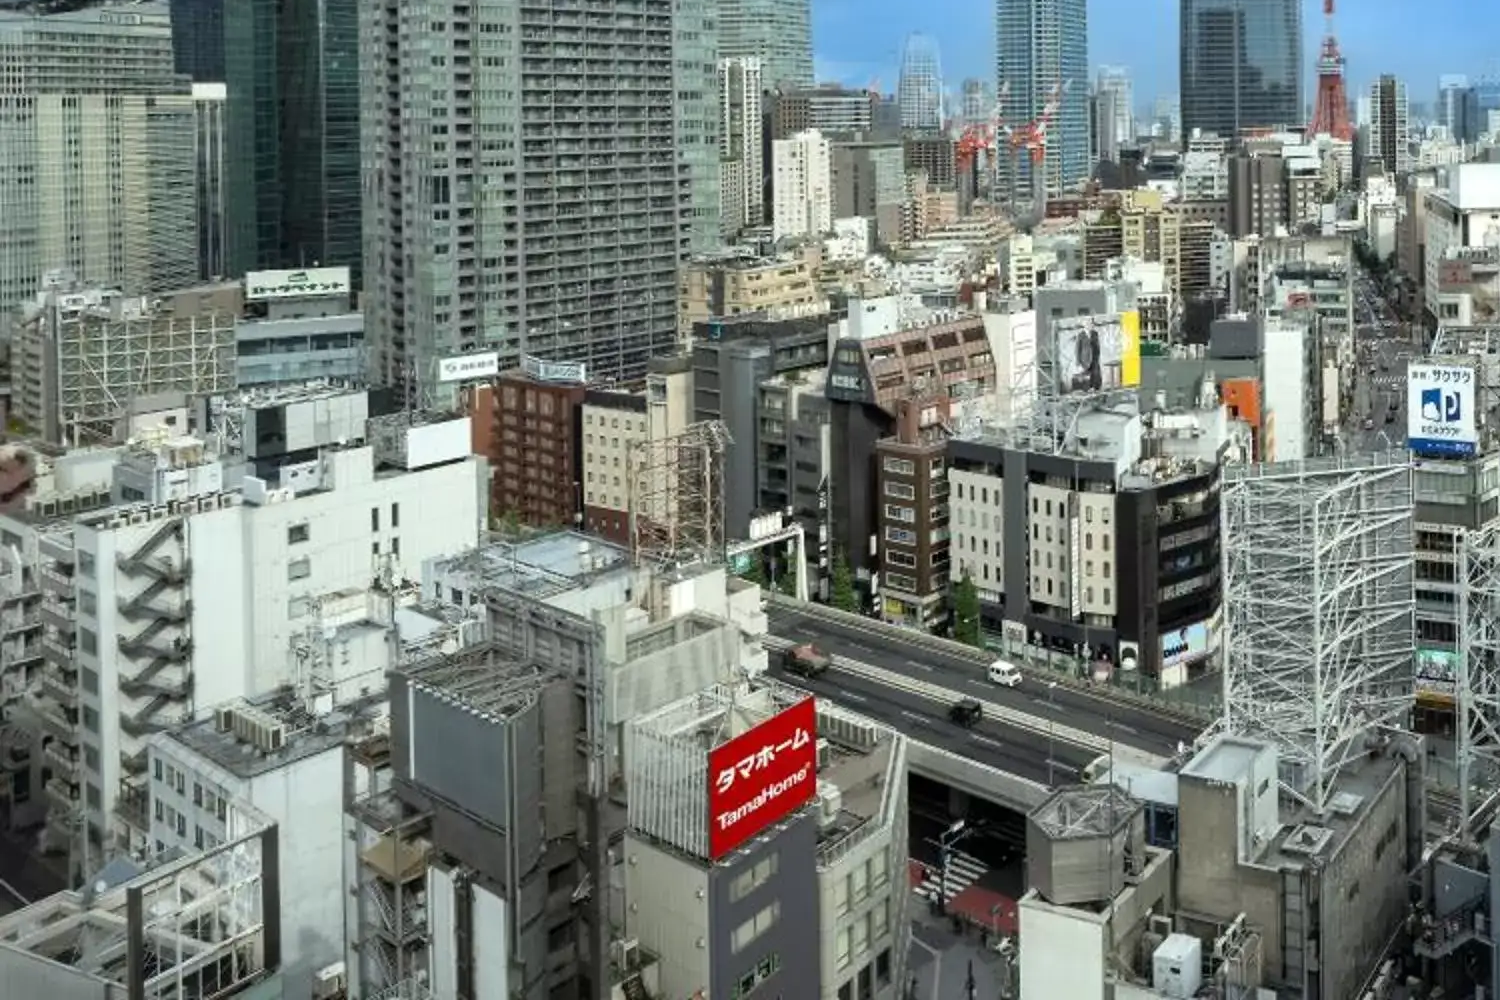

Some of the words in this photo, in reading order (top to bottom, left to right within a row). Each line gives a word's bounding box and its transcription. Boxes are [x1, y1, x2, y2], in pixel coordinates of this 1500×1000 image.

[715, 727, 810, 794] タマホーム
[716, 767, 808, 831] TamaHome
